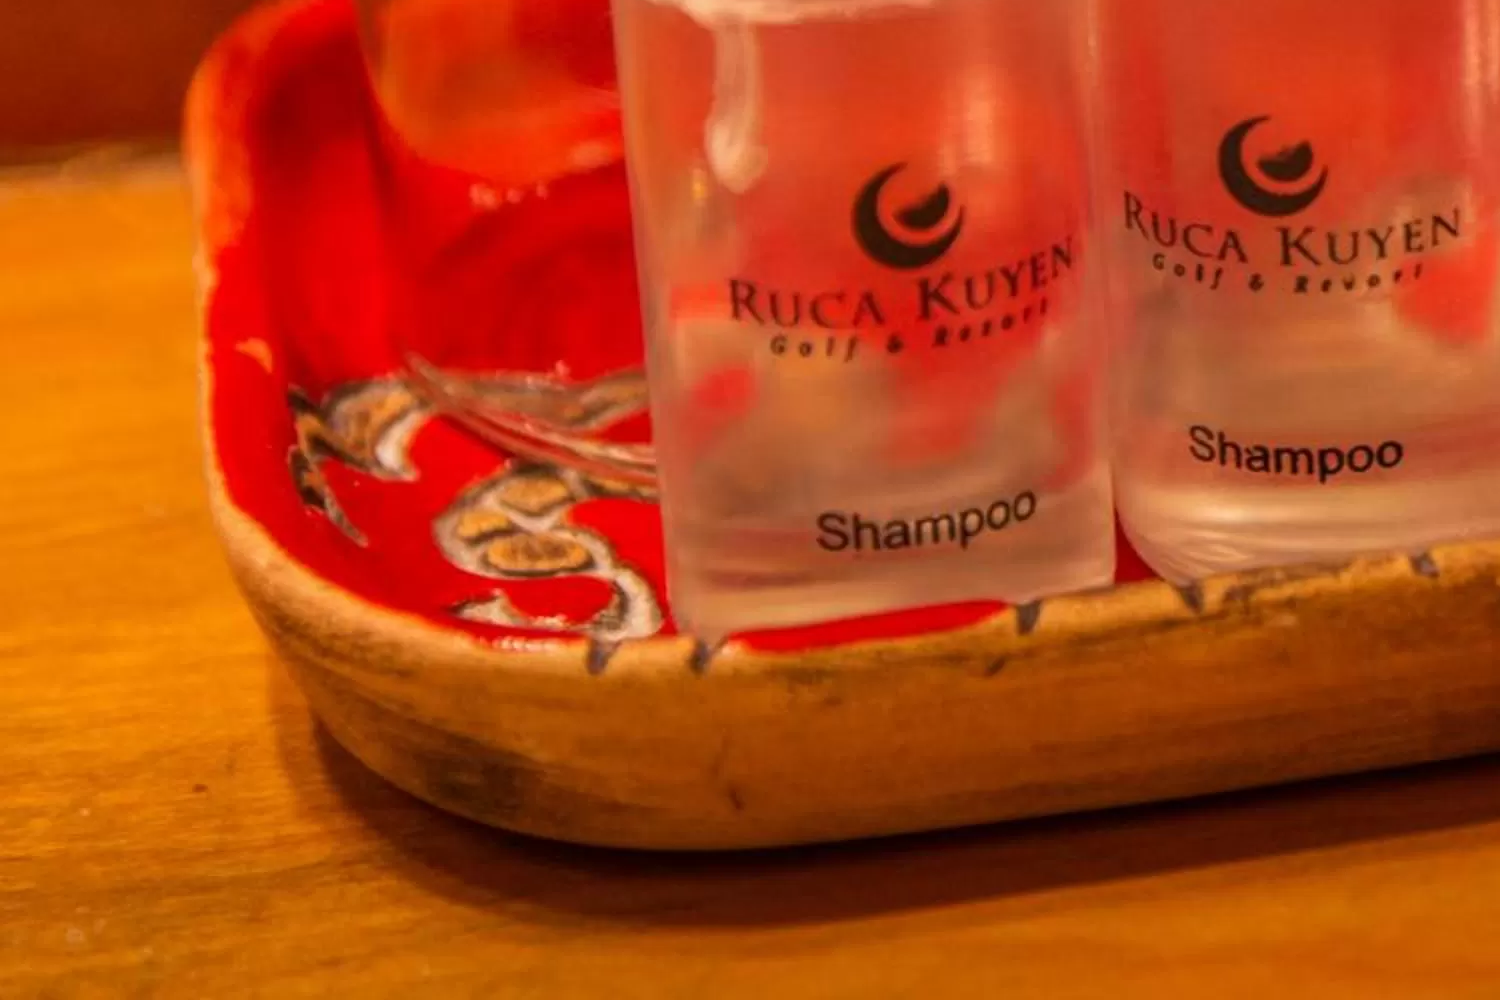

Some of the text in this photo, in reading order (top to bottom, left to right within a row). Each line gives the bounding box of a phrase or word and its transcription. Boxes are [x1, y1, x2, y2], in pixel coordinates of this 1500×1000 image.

[1123, 190, 1462, 267] RUCA KUYEN
[730, 235, 1077, 328] RUCA KUYEN
[770, 335, 860, 362] Golf
[932, 299, 1049, 348] Resort
[1189, 425, 1404, 484] Shampoo
[816, 490, 1037, 551] Shampoo
